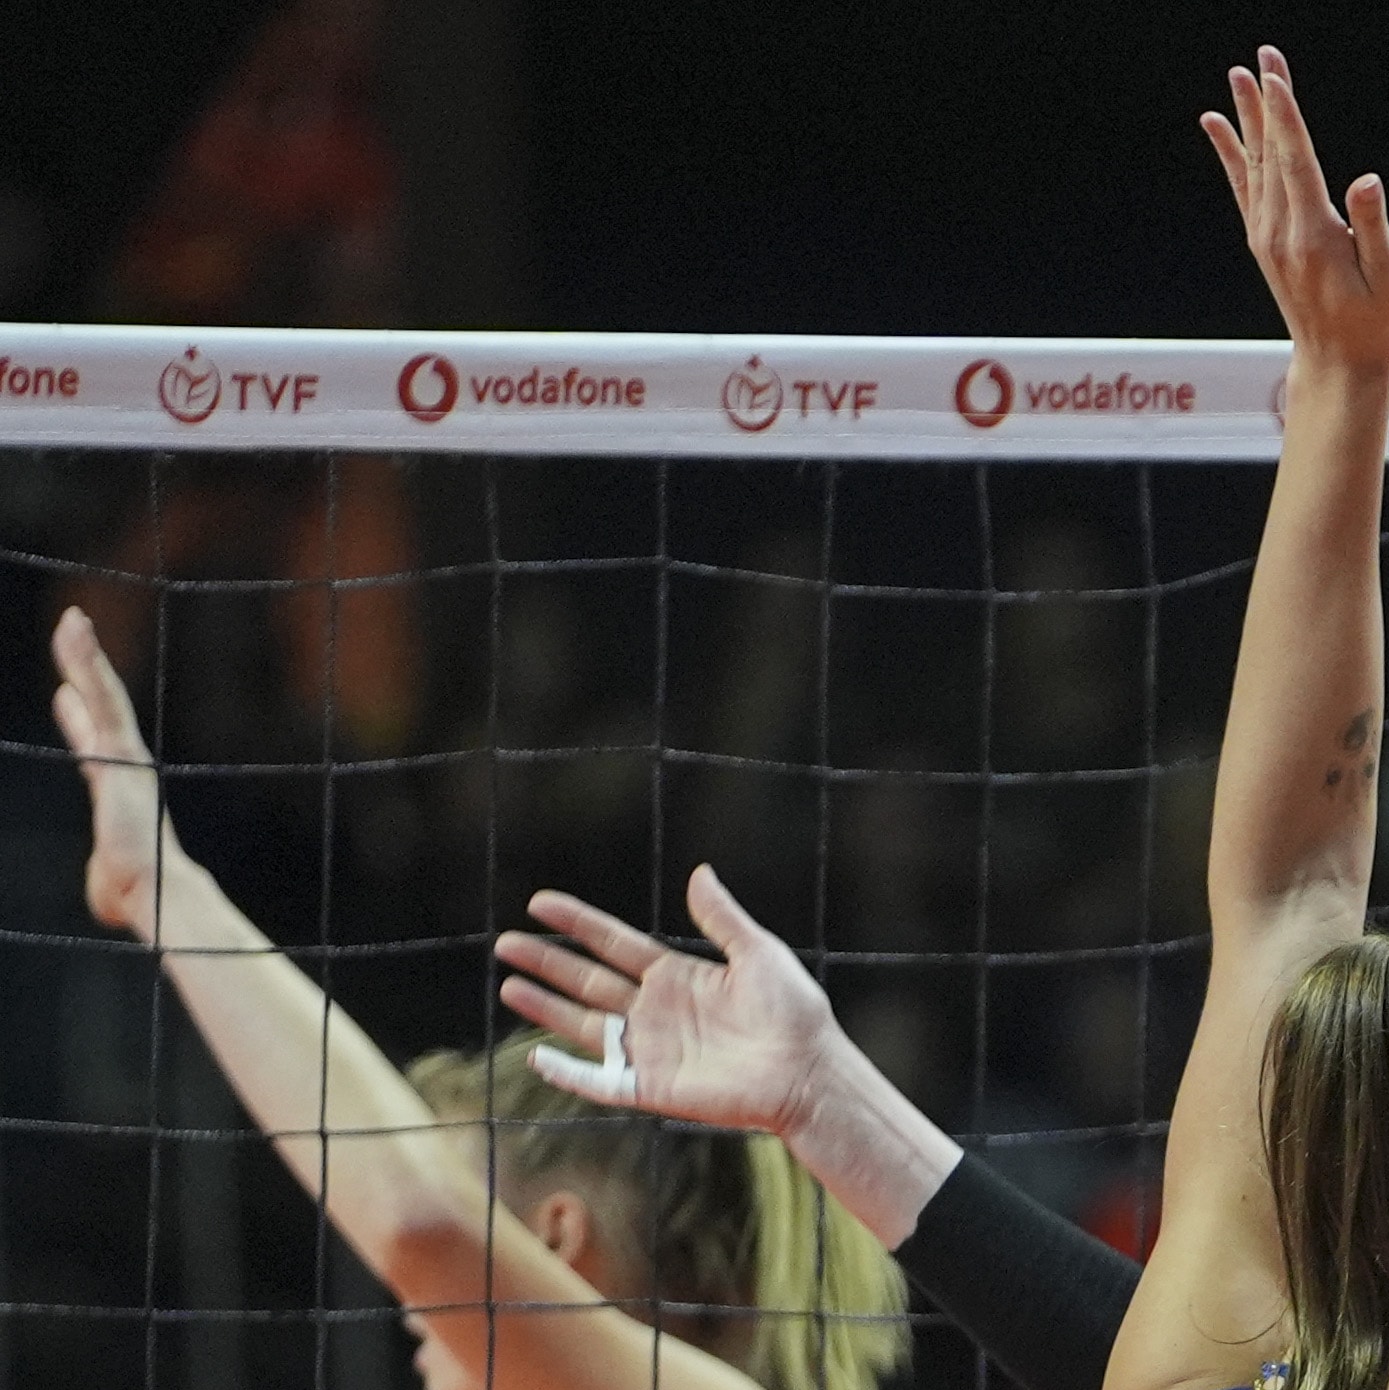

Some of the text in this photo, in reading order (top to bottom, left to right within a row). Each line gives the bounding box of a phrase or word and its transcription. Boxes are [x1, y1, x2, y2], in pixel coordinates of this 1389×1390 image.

[232, 371, 319, 413] TVF
[471, 364, 645, 406] vodafone
[792, 379, 877, 420] TVF
[1026, 368, 1194, 413] vodafone
